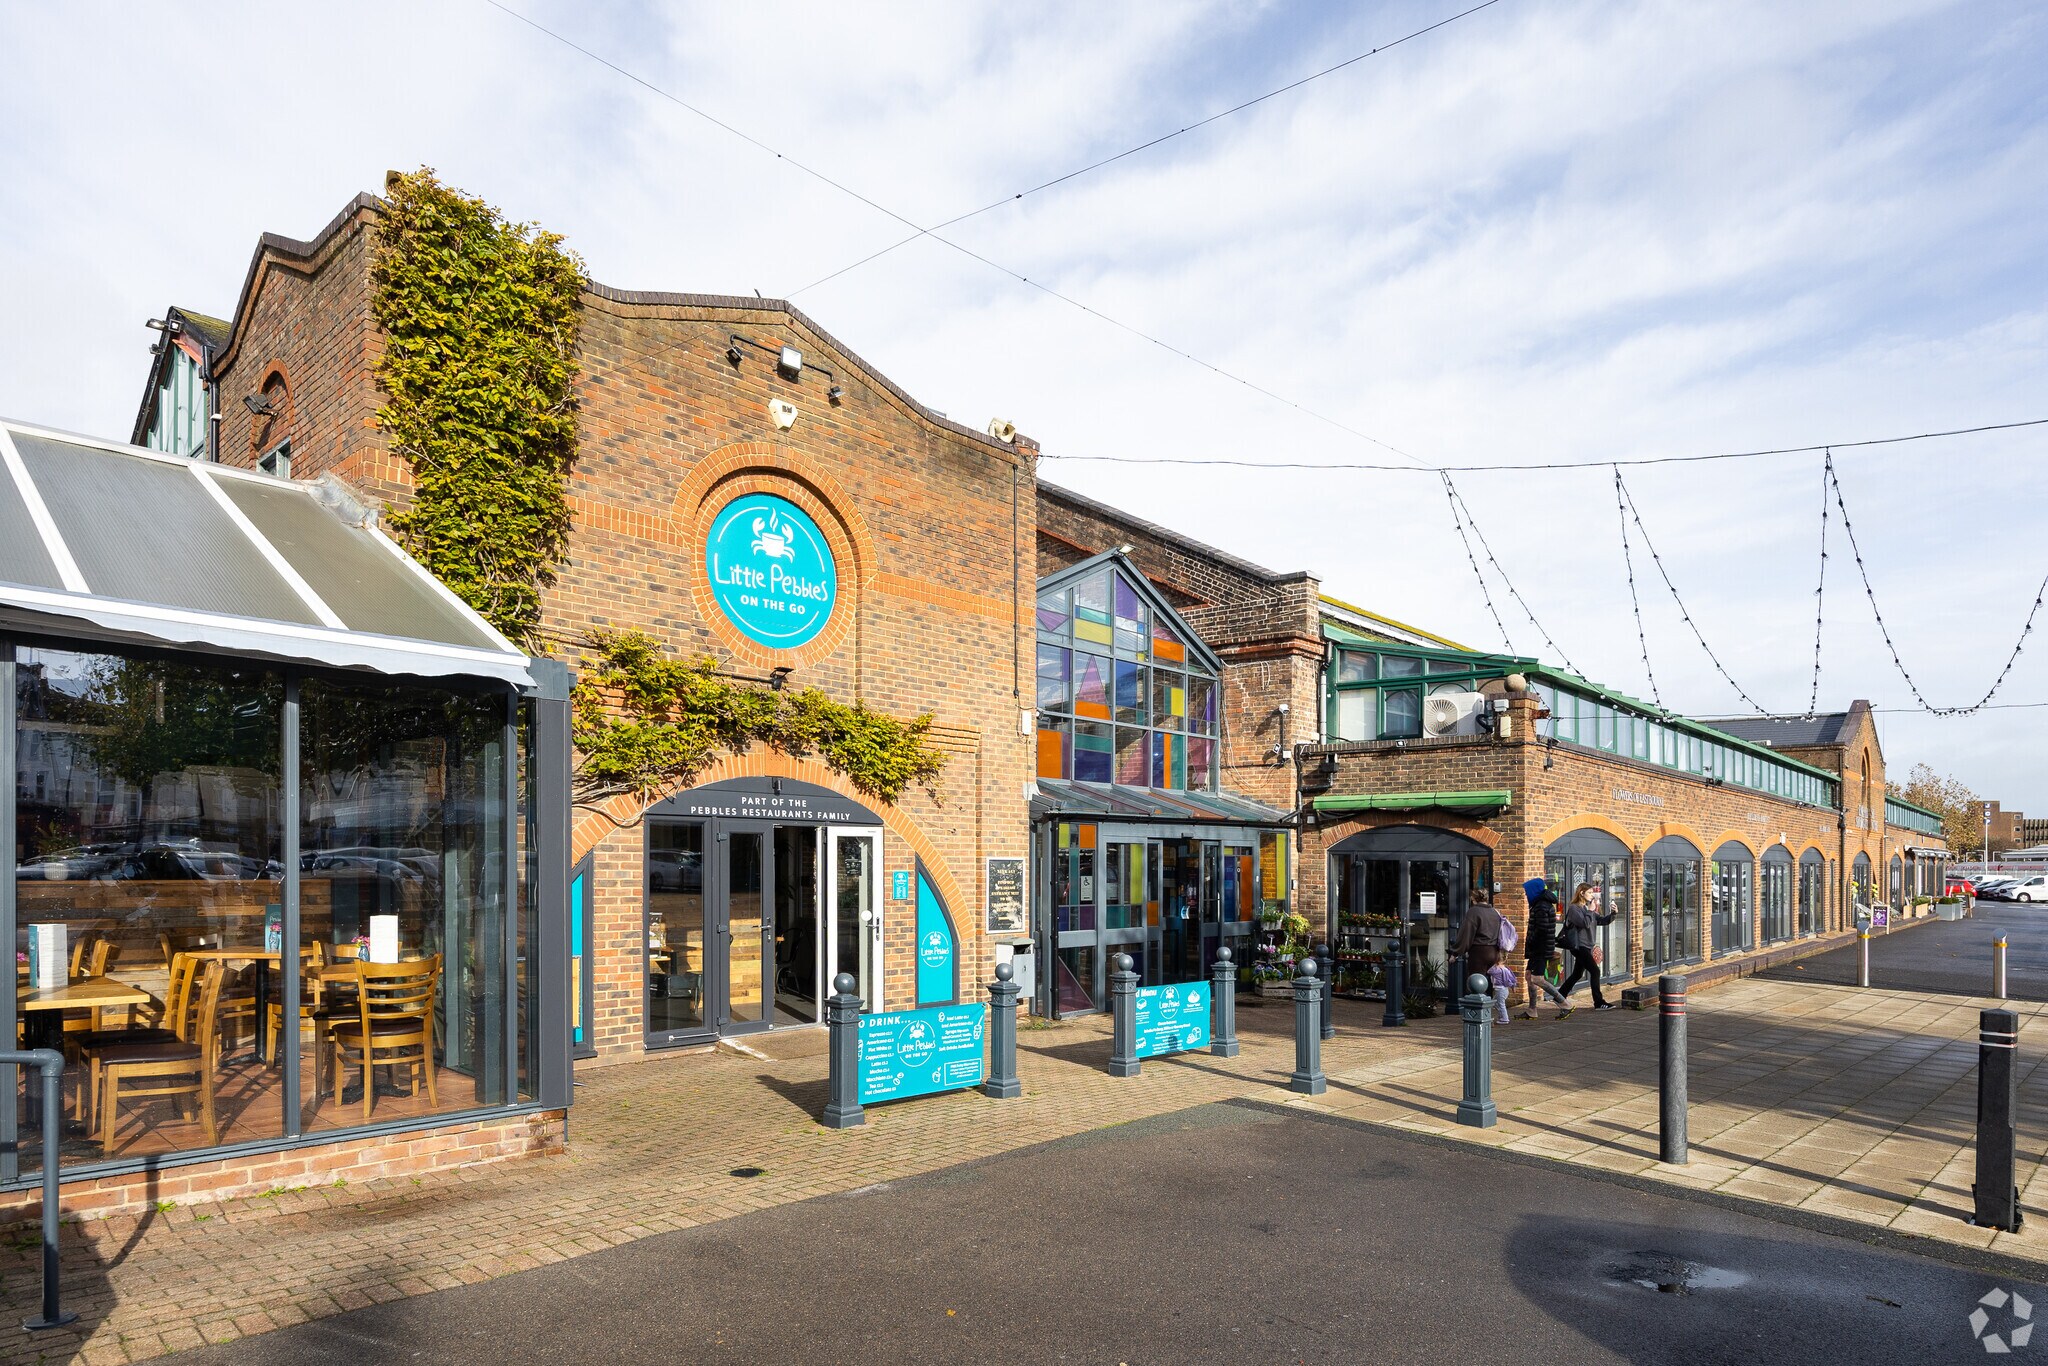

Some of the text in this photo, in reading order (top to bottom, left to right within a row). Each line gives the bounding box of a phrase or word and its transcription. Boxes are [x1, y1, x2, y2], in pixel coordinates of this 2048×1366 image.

[714, 552, 829, 602] Little Pebbles
[740, 594, 806, 615] ON THE GO
[741, 796, 807, 808] PART OF THE
[690, 806, 851, 821] PEBBLES RESTAURANTS FAMILY
